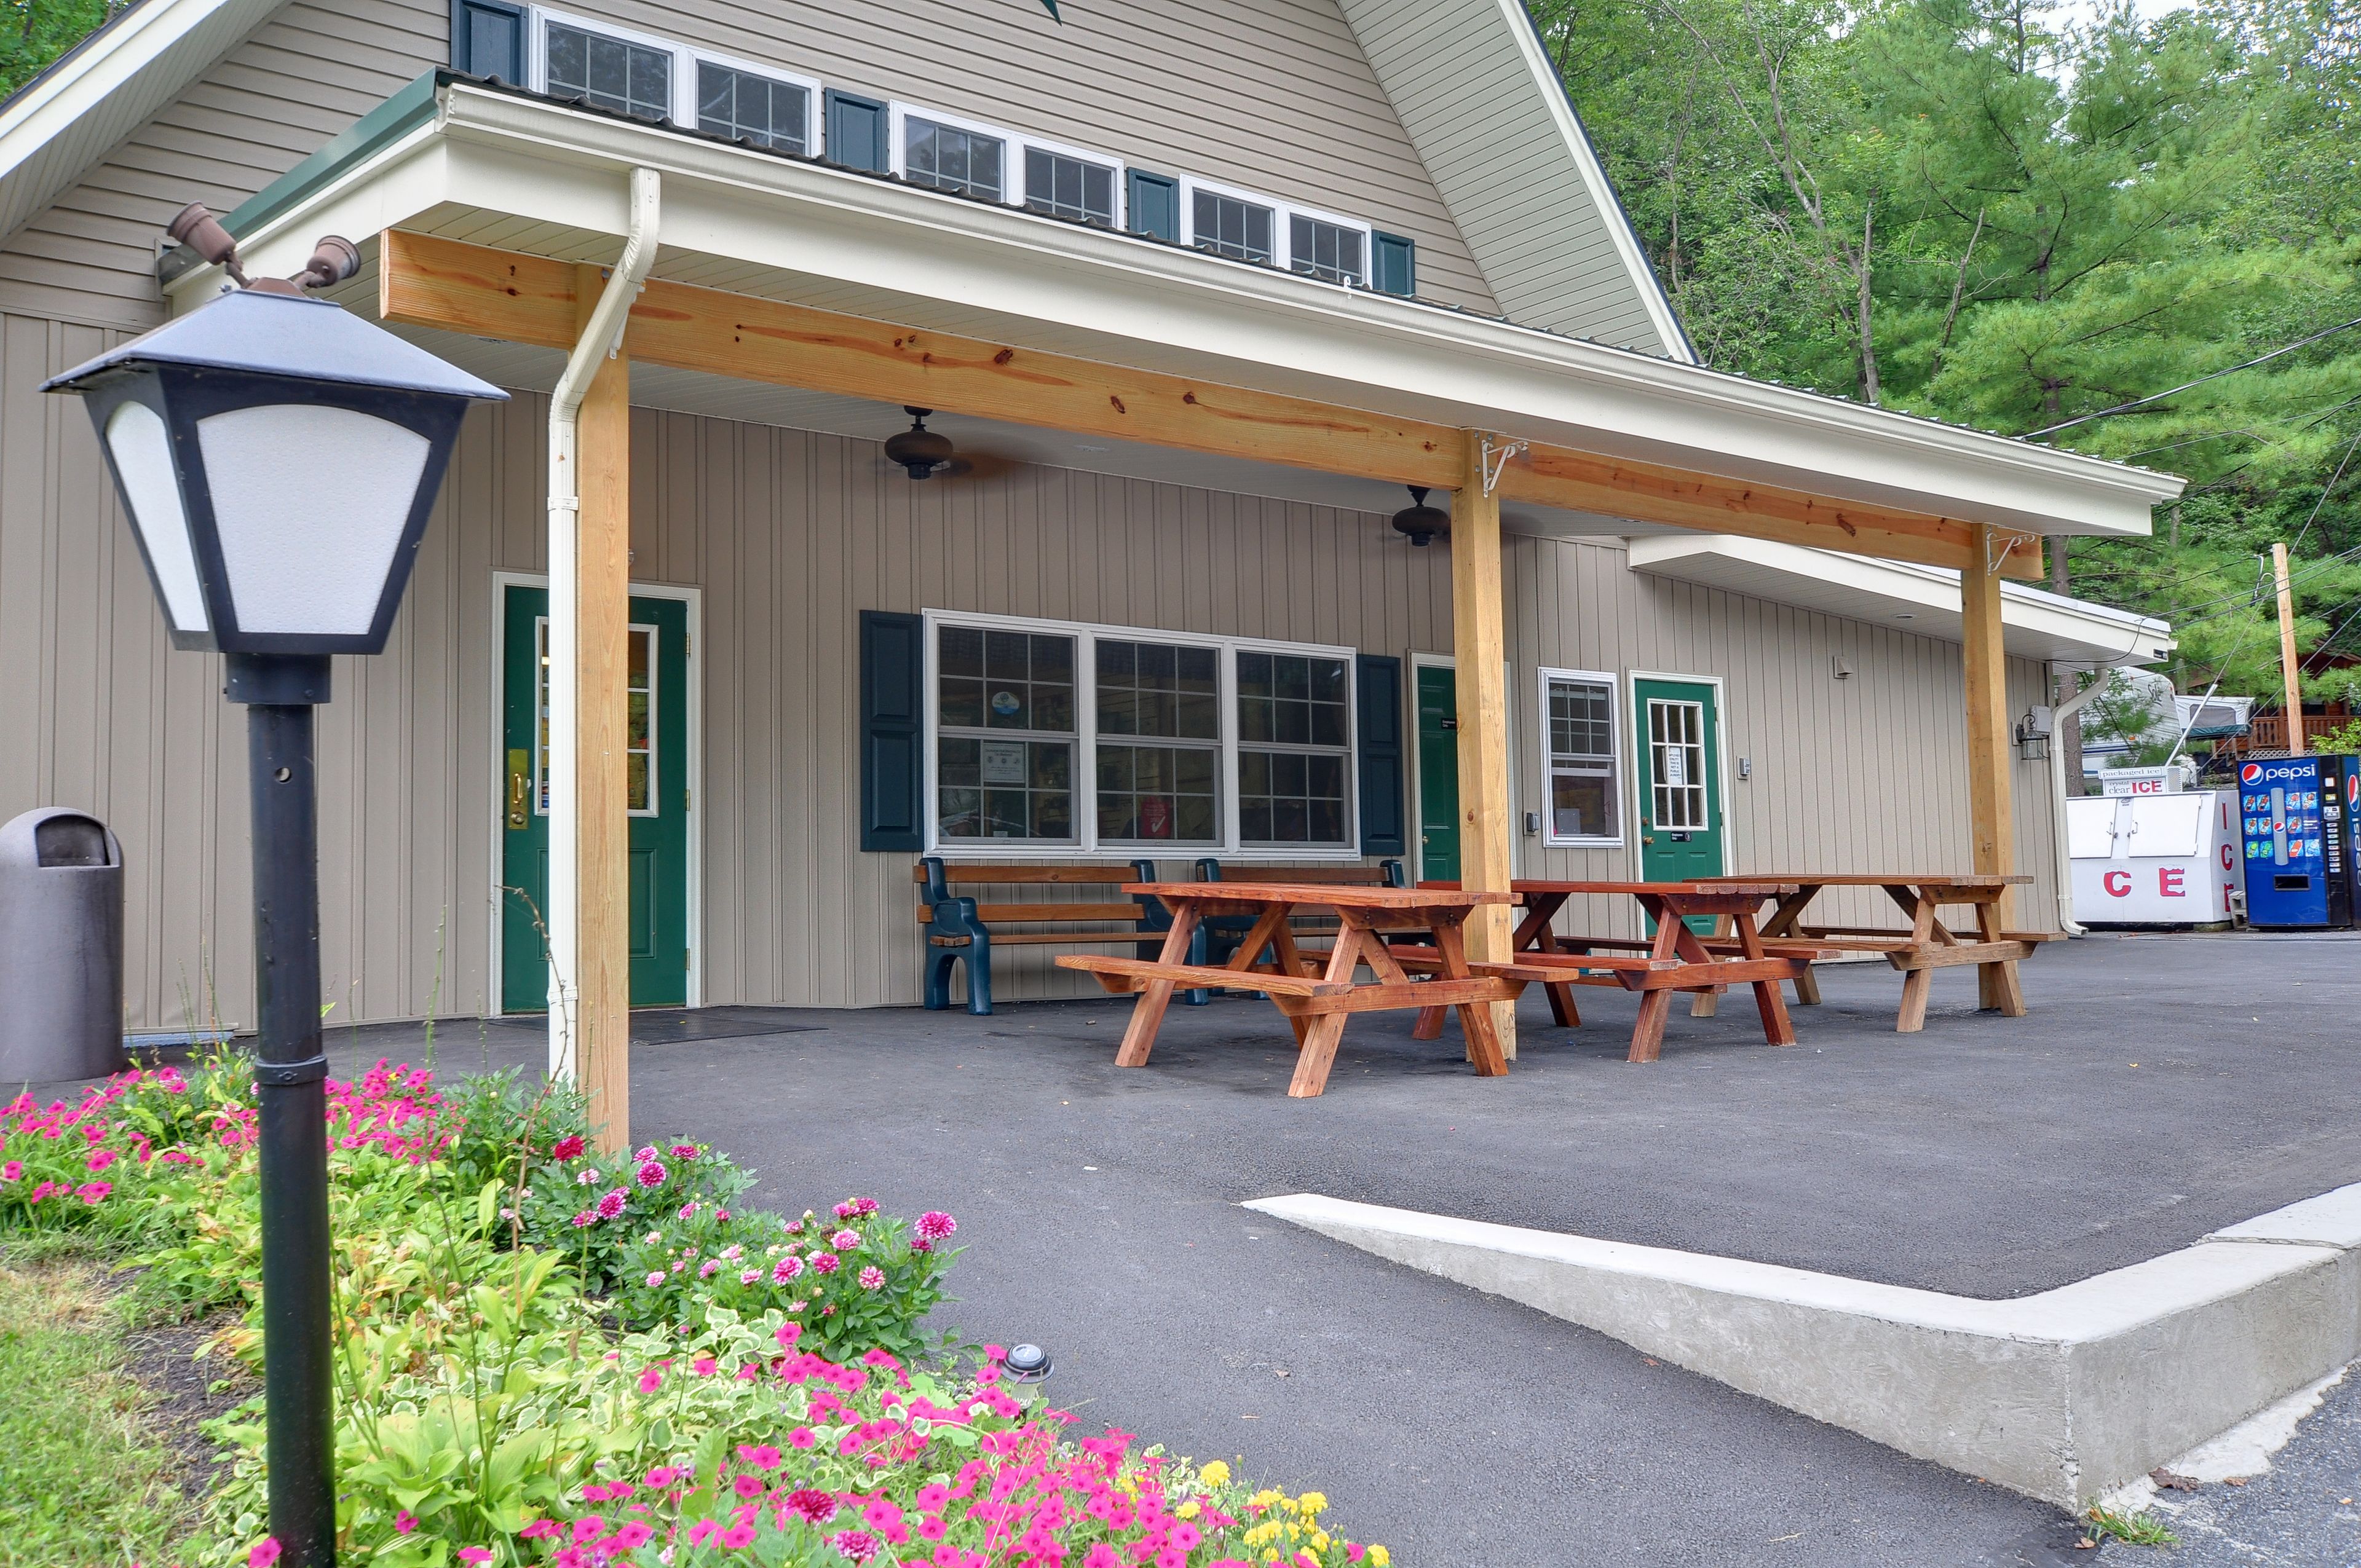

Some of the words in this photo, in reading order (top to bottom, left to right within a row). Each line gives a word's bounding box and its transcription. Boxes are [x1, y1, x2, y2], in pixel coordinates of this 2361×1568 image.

[2103, 769, 2144, 778] packaged
[2266, 764, 2316, 781] pepsi
[2132, 780, 2162, 794] ICE
